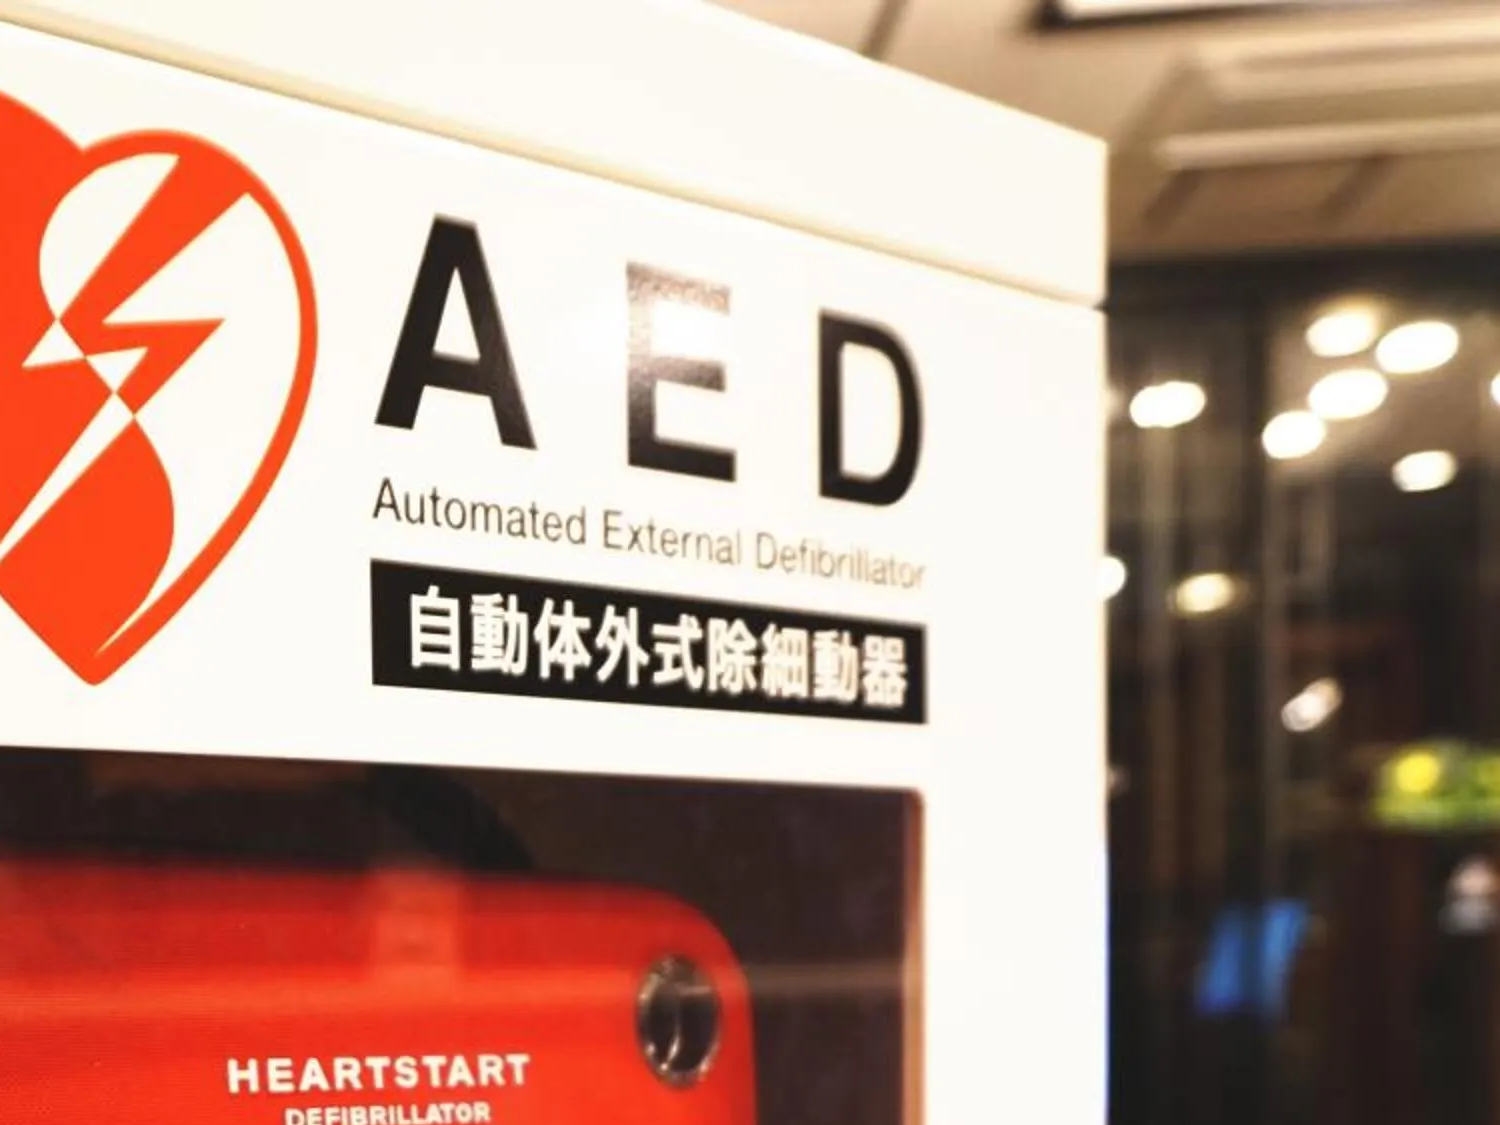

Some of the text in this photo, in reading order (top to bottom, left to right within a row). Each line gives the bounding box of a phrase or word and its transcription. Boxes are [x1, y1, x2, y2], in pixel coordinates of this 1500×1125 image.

[374, 212, 925, 508] AED
[372, 477, 926, 590] Automated External Defibrillator
[409, 585, 909, 709] 自動体外式除細動器
[226, 1052, 531, 1094] HEARTSTART
